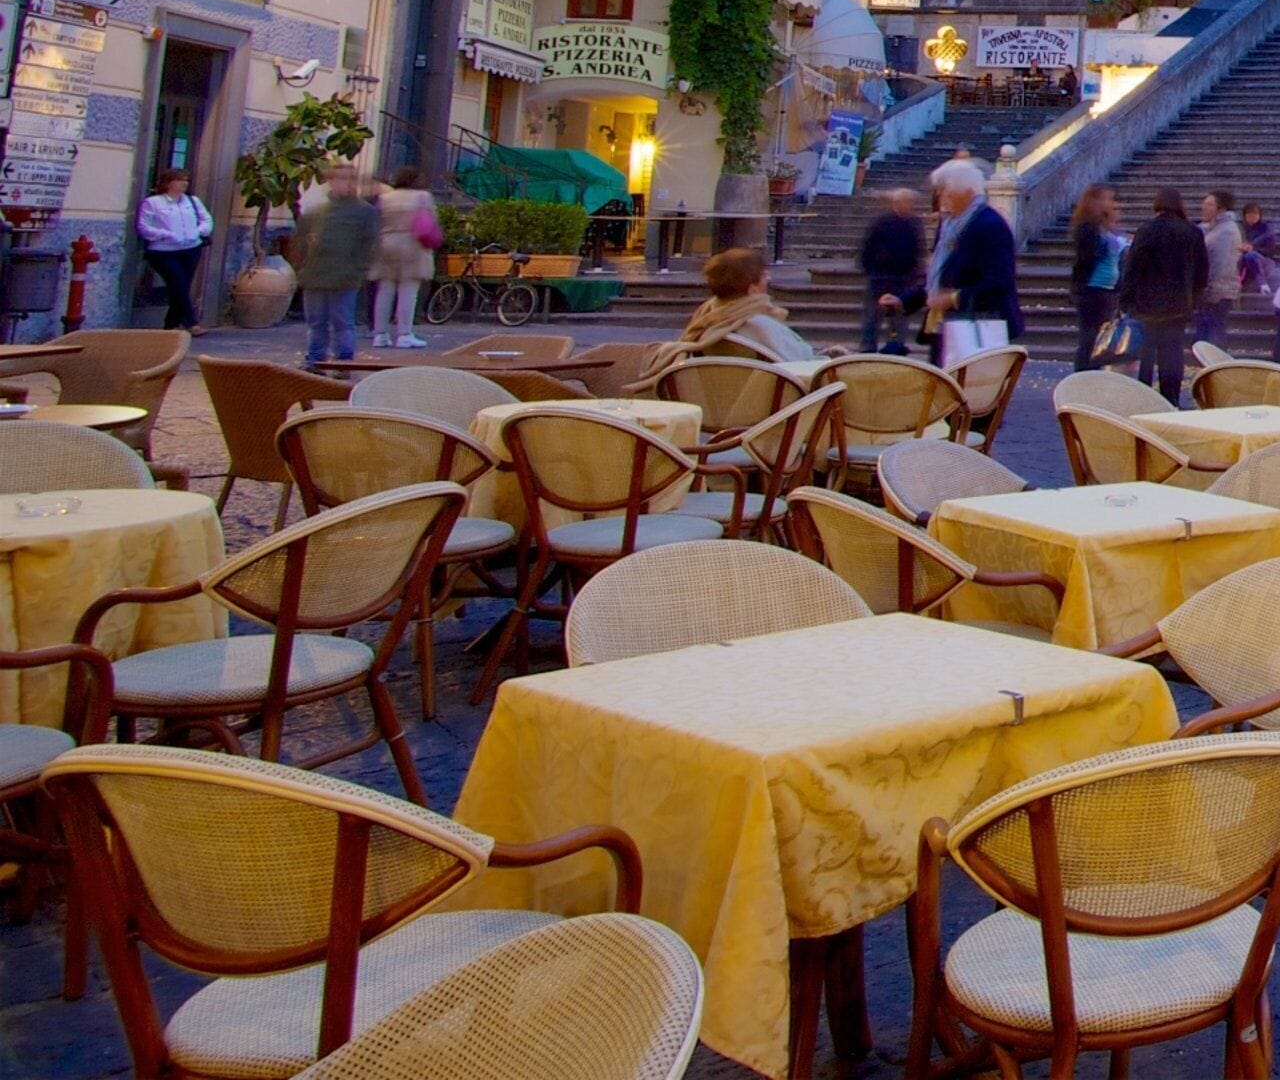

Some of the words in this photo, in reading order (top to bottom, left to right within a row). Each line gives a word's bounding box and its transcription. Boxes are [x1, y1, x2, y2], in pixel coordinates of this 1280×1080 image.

[498, 8, 526, 29] PIZZERIA
[503, 27, 528, 45] ANDREA
[579, 24, 595, 33] dal
[988, 29, 1022, 48] TAVERNA
[1034, 29, 1069, 51] APOSTOLI
[553, 49, 645, 66] PIZZERIA
[985, 51, 1067, 65] RISTORANTE
[542, 65, 560, 78] S.
[571, 62, 652, 81] ANDREA
[7, 142, 28, 152] HAIR
